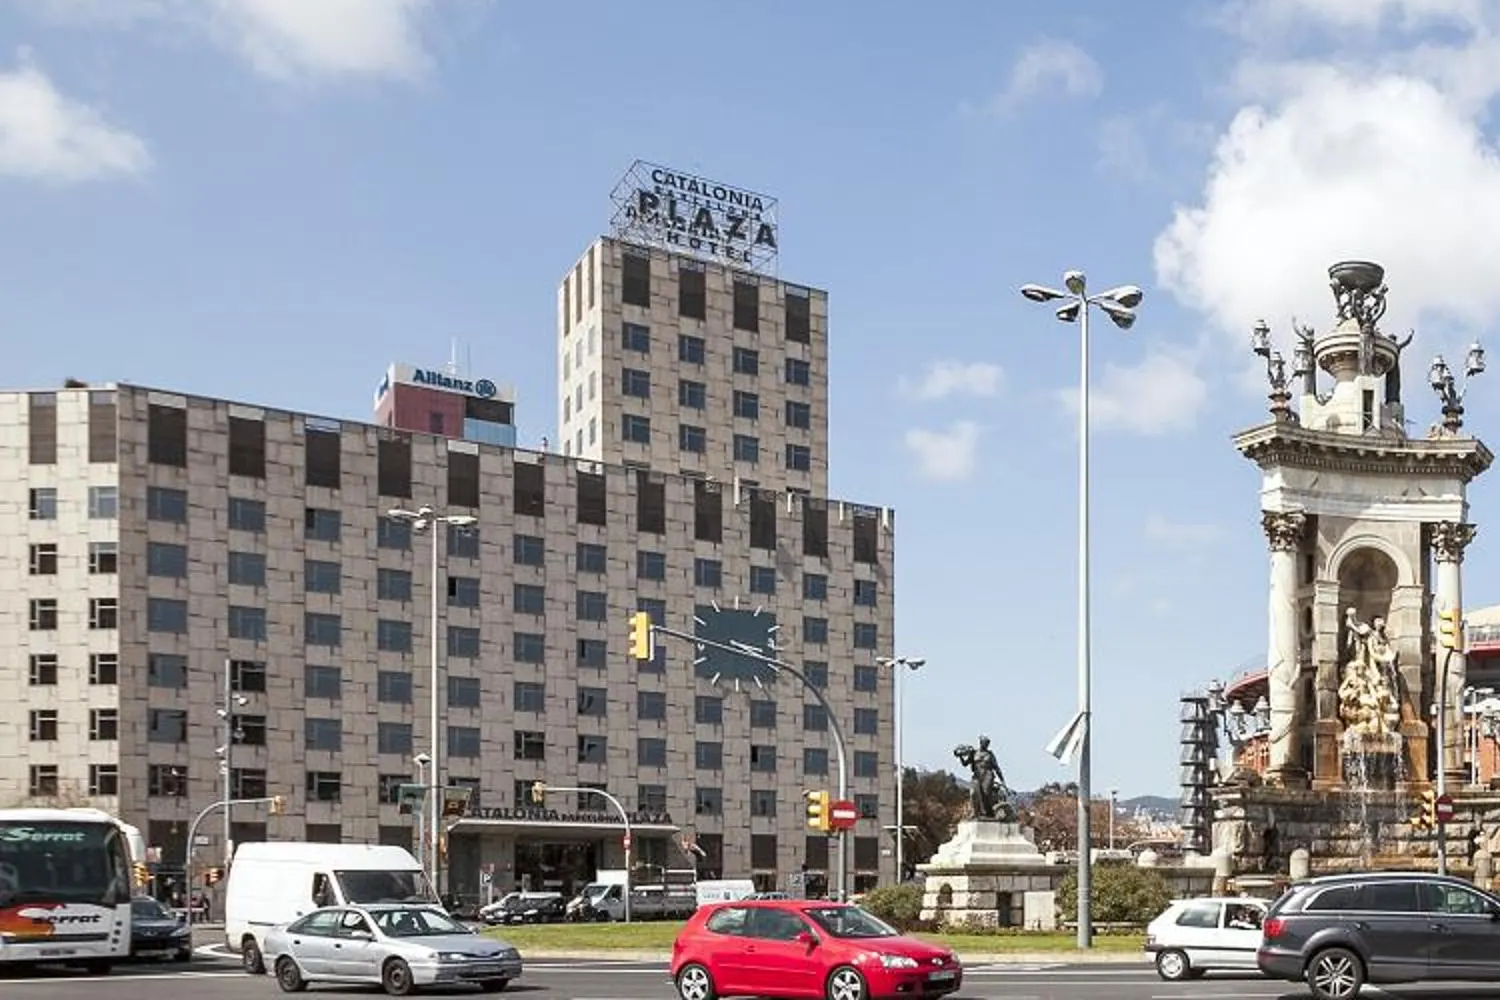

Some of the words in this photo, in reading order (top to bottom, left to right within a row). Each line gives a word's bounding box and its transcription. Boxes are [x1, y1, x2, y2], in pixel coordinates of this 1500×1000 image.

[652, 169, 764, 212] CATALONIA
[638, 190, 778, 248] PLAZA
[666, 230, 753, 263] HOTEL
[413, 369, 473, 393] Allianz
[464, 807, 561, 820] ATALONIA
